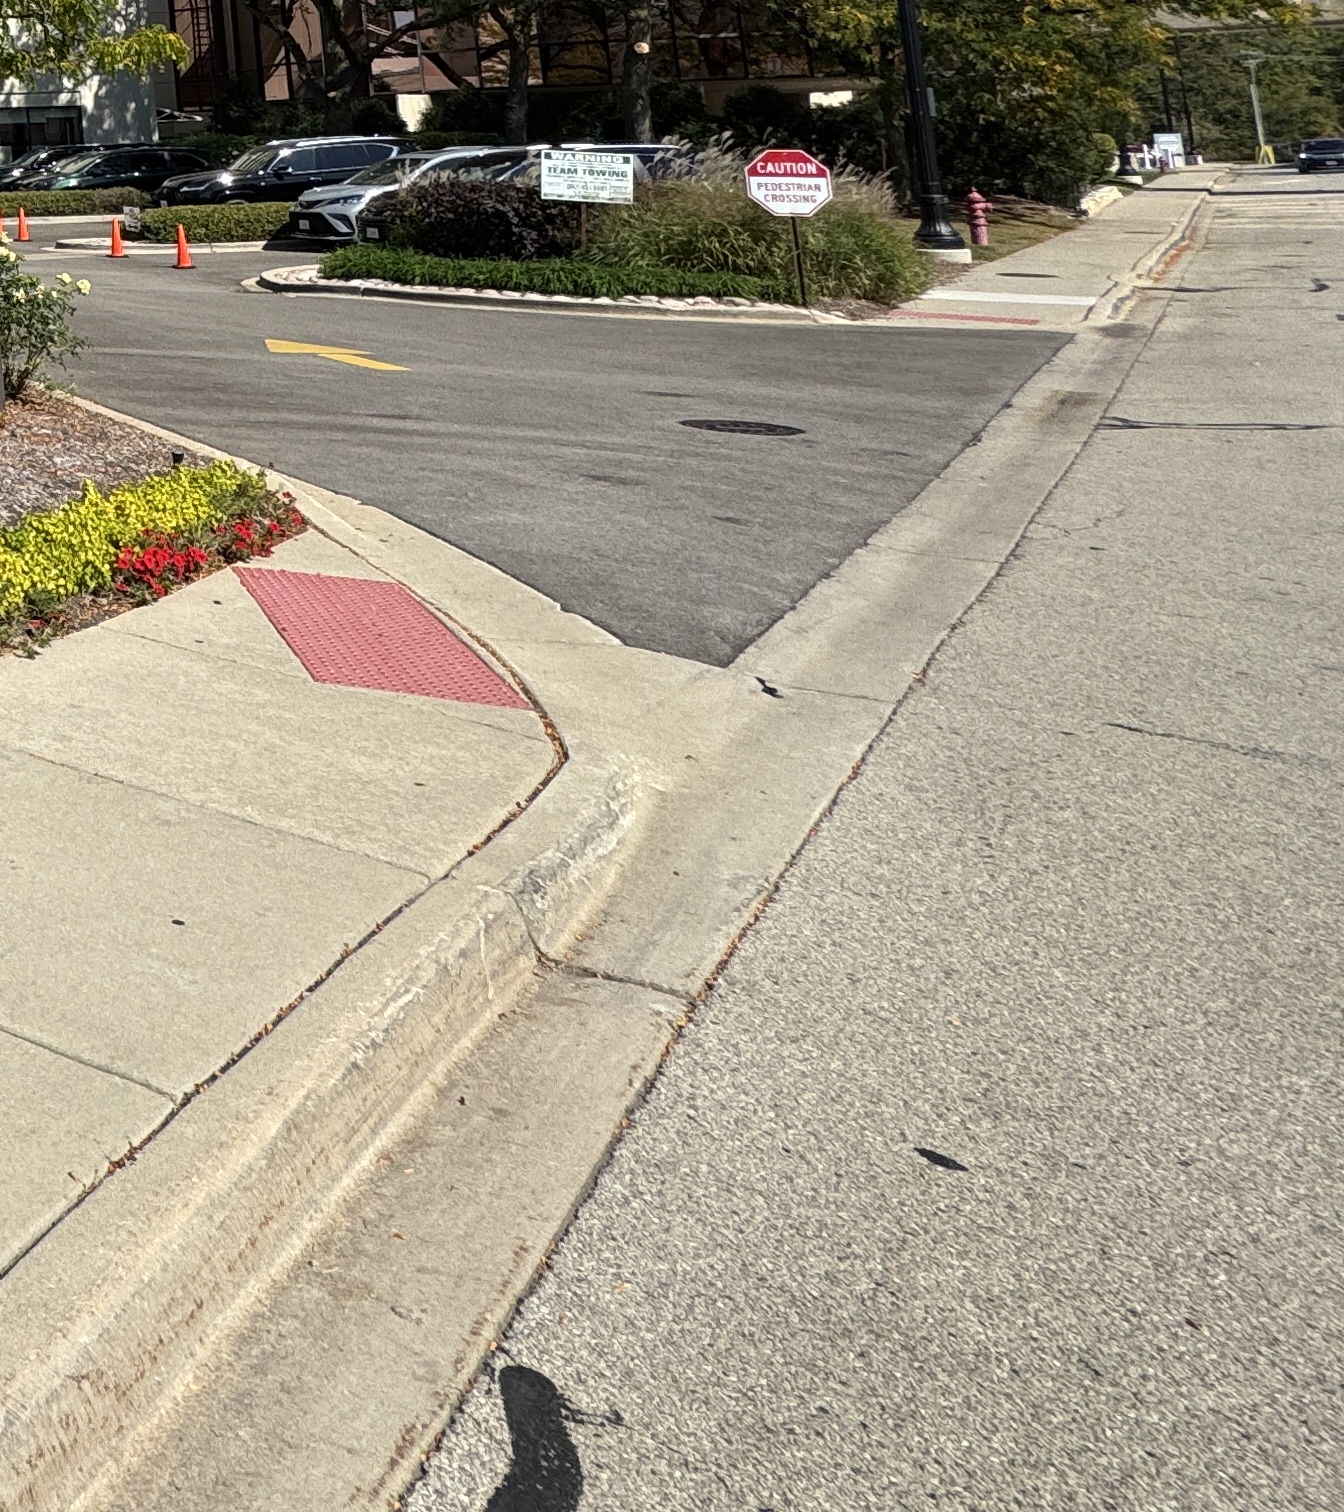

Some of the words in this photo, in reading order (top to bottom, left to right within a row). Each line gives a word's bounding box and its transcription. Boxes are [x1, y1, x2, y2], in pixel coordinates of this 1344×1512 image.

[550, 152, 624, 164] WARNING
[547, 166, 578, 175] TEAM
[582, 168, 629, 179] TOWING
[756, 161, 818, 175] CAUTION
[756, 182, 822, 193] PEDESTRIAN
[763, 193, 818, 204] CROSSING
